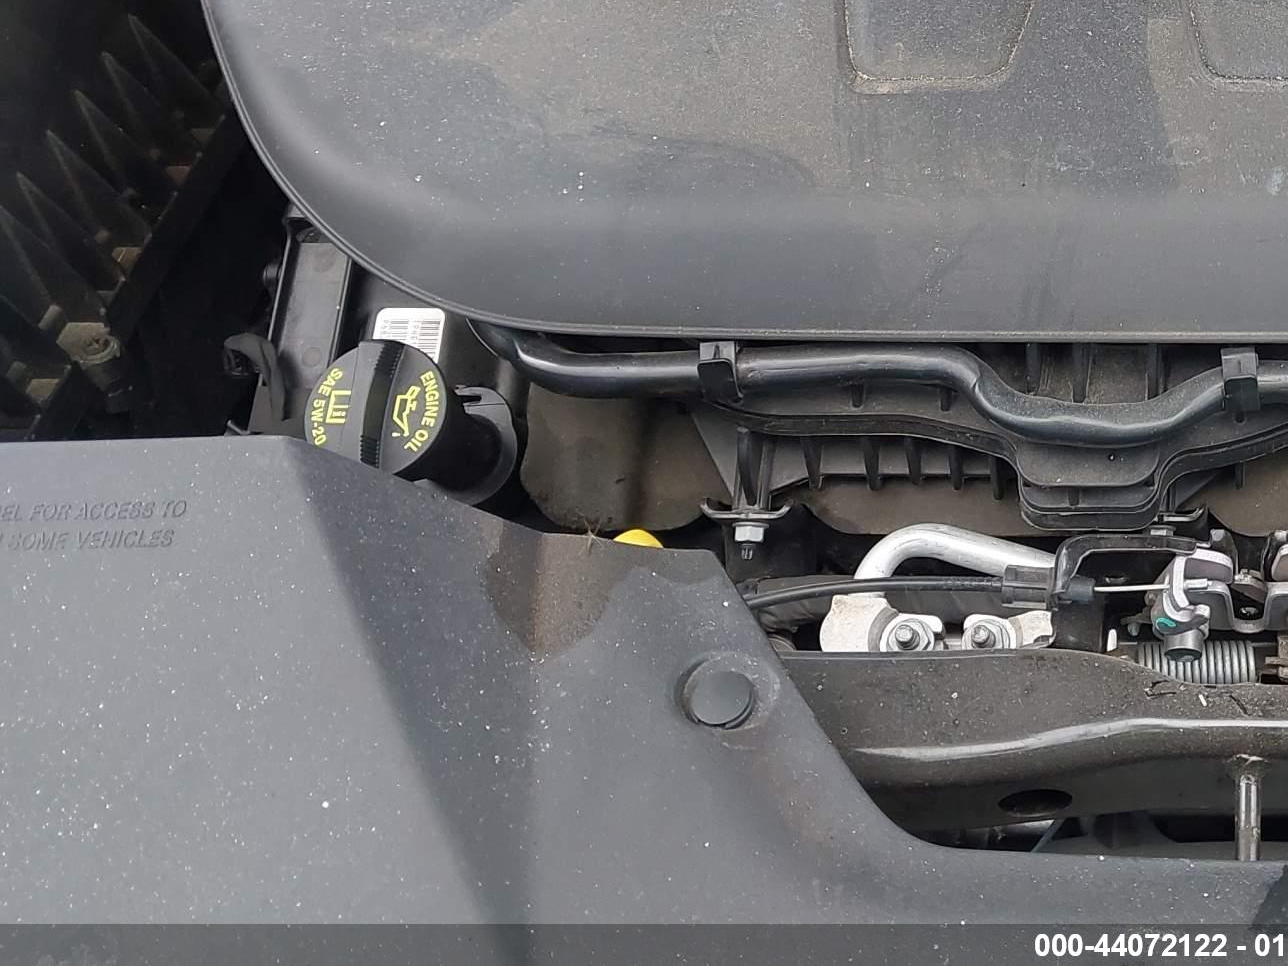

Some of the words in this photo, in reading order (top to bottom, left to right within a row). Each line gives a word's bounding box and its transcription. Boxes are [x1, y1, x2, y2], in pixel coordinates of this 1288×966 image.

[318, 368, 343, 396] SAE
[420, 370, 440, 428] ENGINE
[311, 399, 327, 446] 5W-20
[404, 430, 429, 452] OIL
[29, 503, 72, 521] FOR
[74, 500, 156, 521] ACCESS
[160, 499, 188, 518] TO
[8, 531, 68, 551] SOME
[78, 528, 176, 549] VEHICLES
